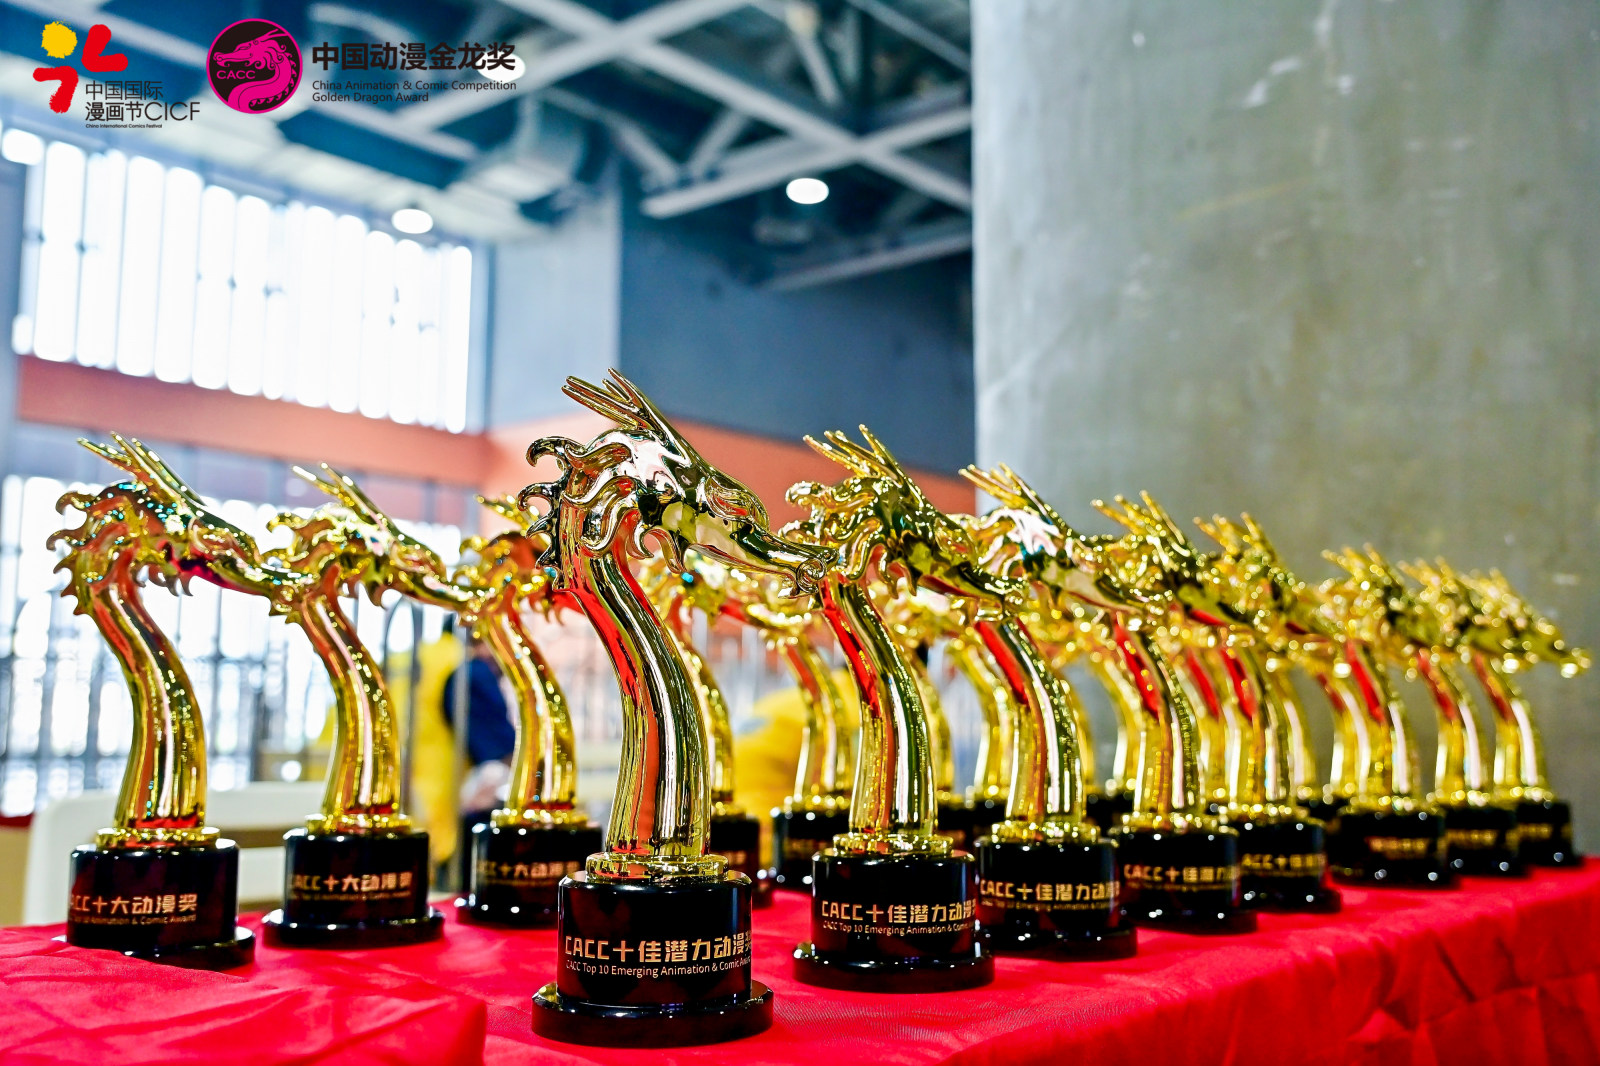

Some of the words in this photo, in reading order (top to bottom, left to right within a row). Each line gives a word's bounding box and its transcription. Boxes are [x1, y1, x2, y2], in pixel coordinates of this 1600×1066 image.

[854, 924, 863, 933] 10
[864, 924, 905, 936] Emerging
[906, 923, 946, 934] Animation
[582, 962, 597, 976] Top
[598, 964, 610, 975] 10
[611, 965, 659, 979] Emerging
[660, 963, 710, 976] Animation
[711, 962, 718, 972] &
[719, 958, 740, 971] Comic
